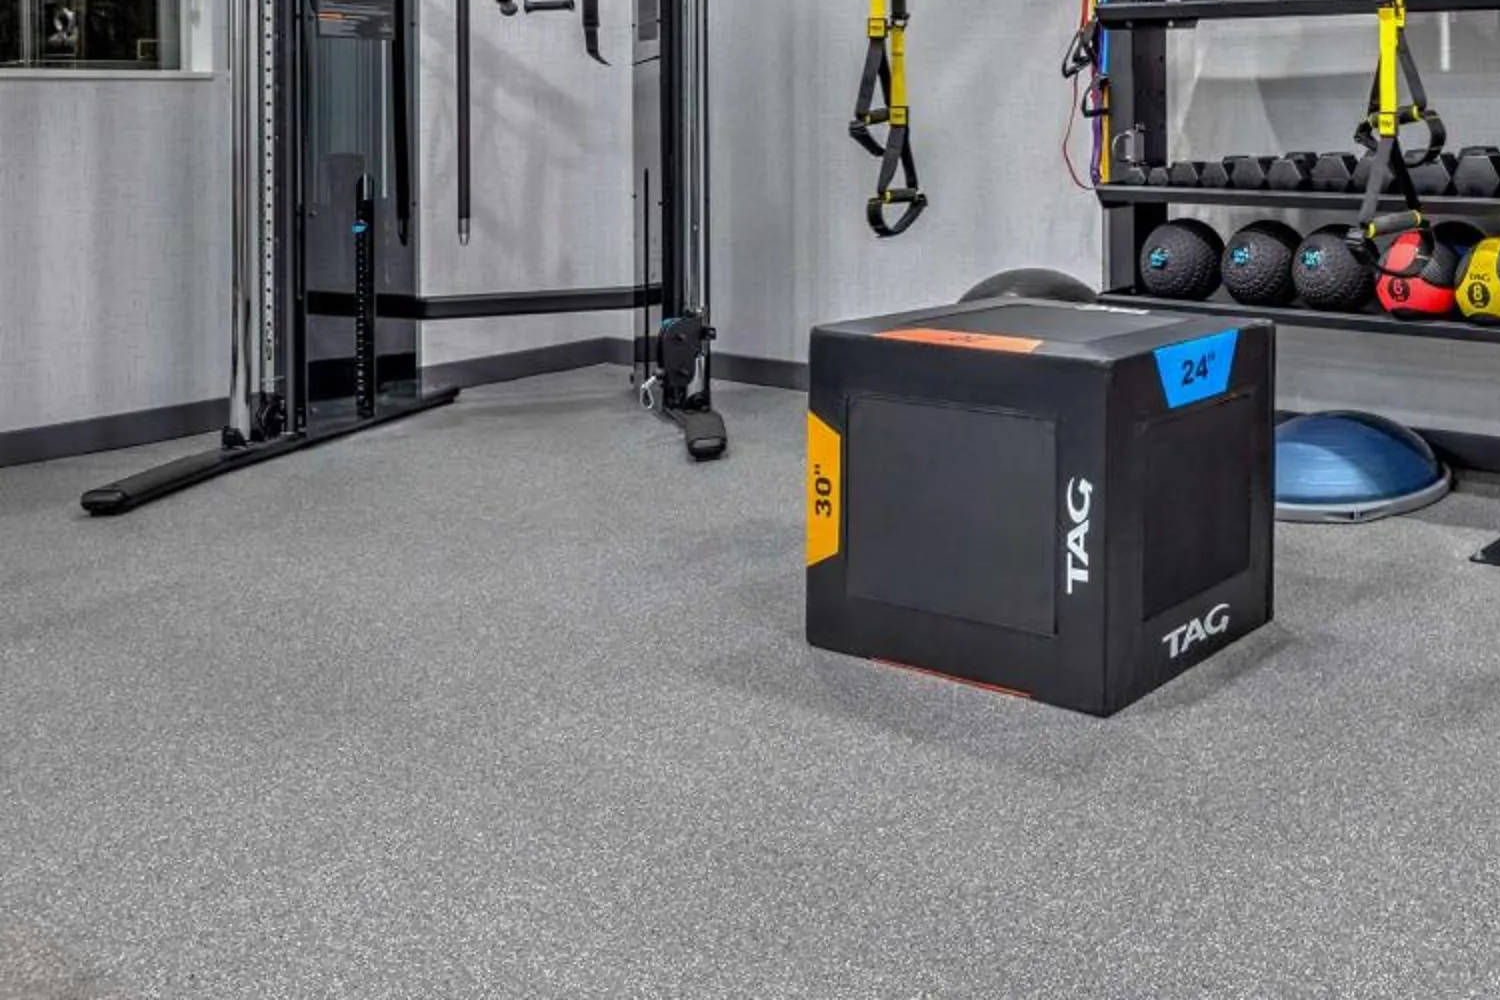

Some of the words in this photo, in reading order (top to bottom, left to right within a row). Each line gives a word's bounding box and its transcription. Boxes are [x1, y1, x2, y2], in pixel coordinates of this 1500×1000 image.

[1473, 285, 1483, 301] 8
[1182, 352, 1216, 386] 24"
[814, 463, 832, 517] 30"
[1066, 477, 1093, 595] TAG
[1162, 603, 1230, 659] TAG
